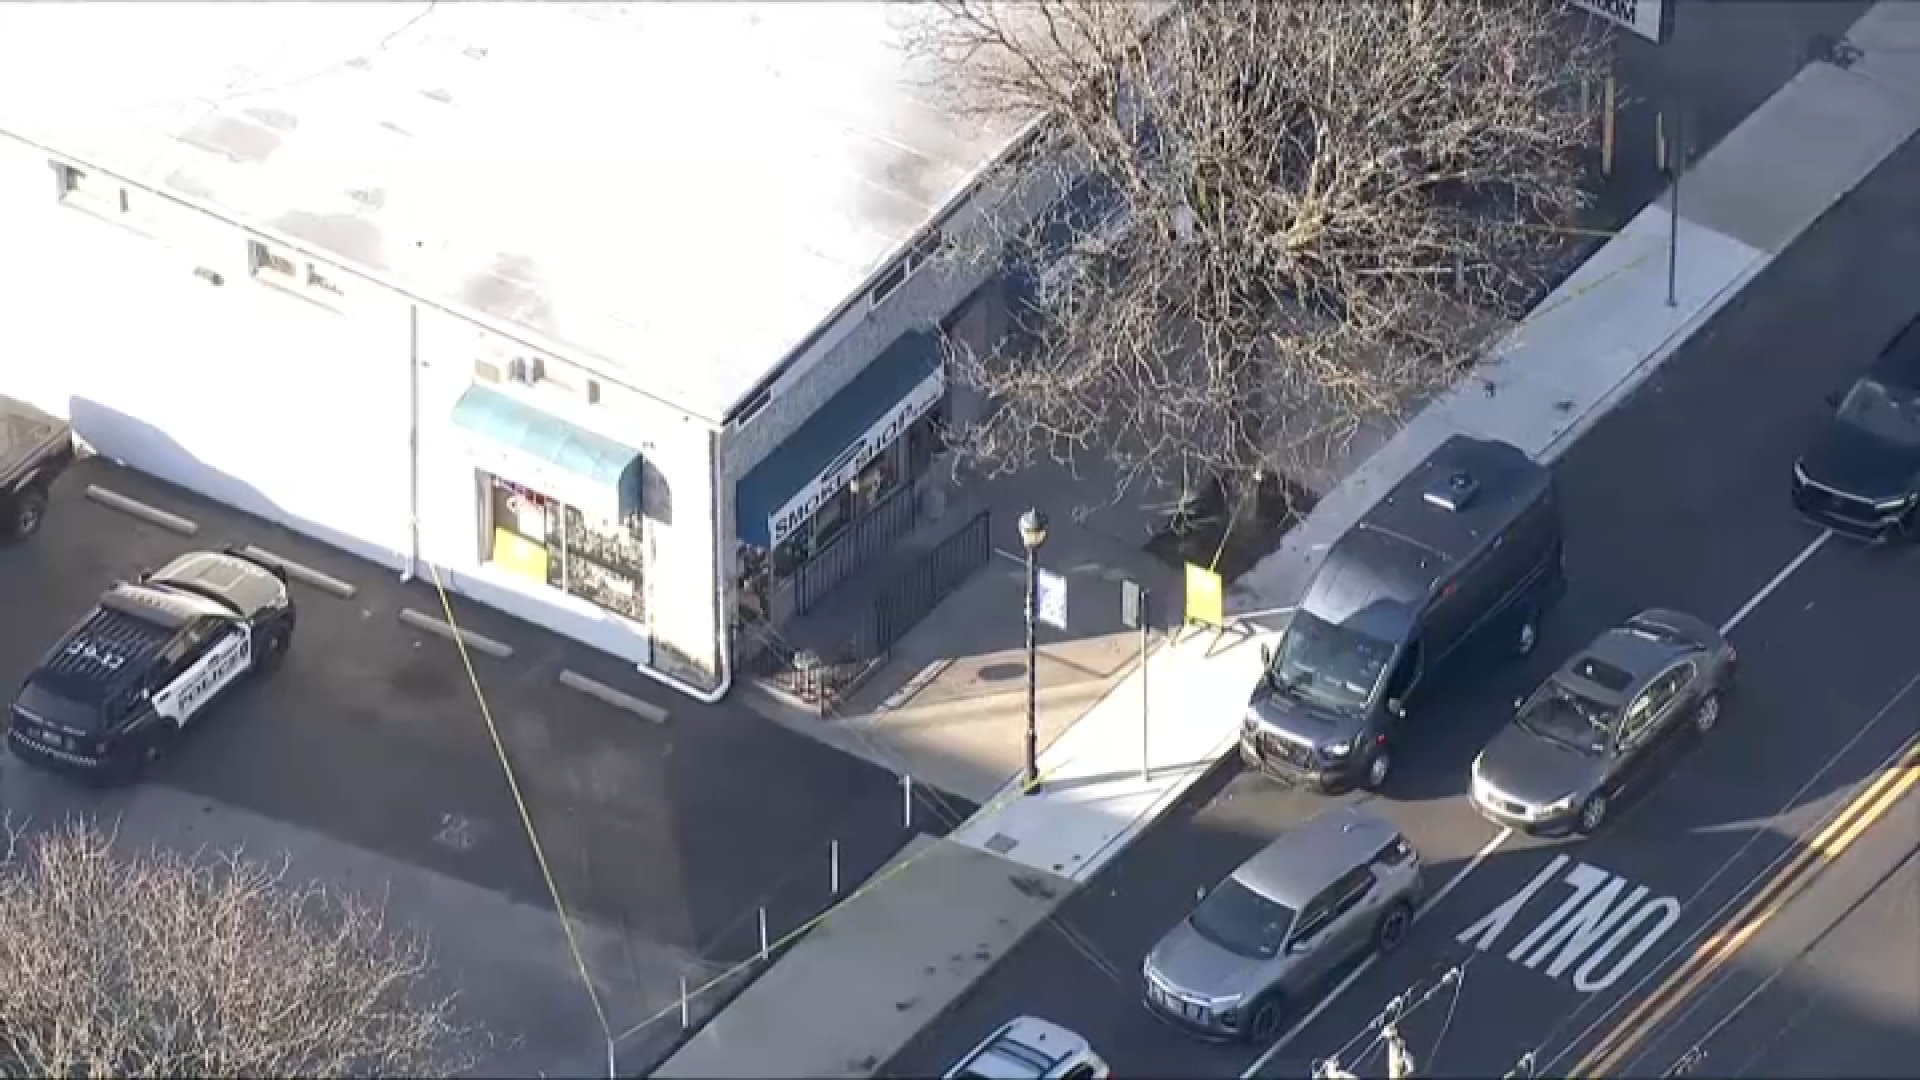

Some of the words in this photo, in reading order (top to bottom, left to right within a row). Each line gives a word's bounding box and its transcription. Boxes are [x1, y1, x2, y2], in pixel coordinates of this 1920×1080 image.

[775, 475, 844, 539] SMOKE
[855, 404, 914, 476] SHOP
[178, 653, 238, 709] POLICE
[1455, 853, 1681, 992] ONLY
